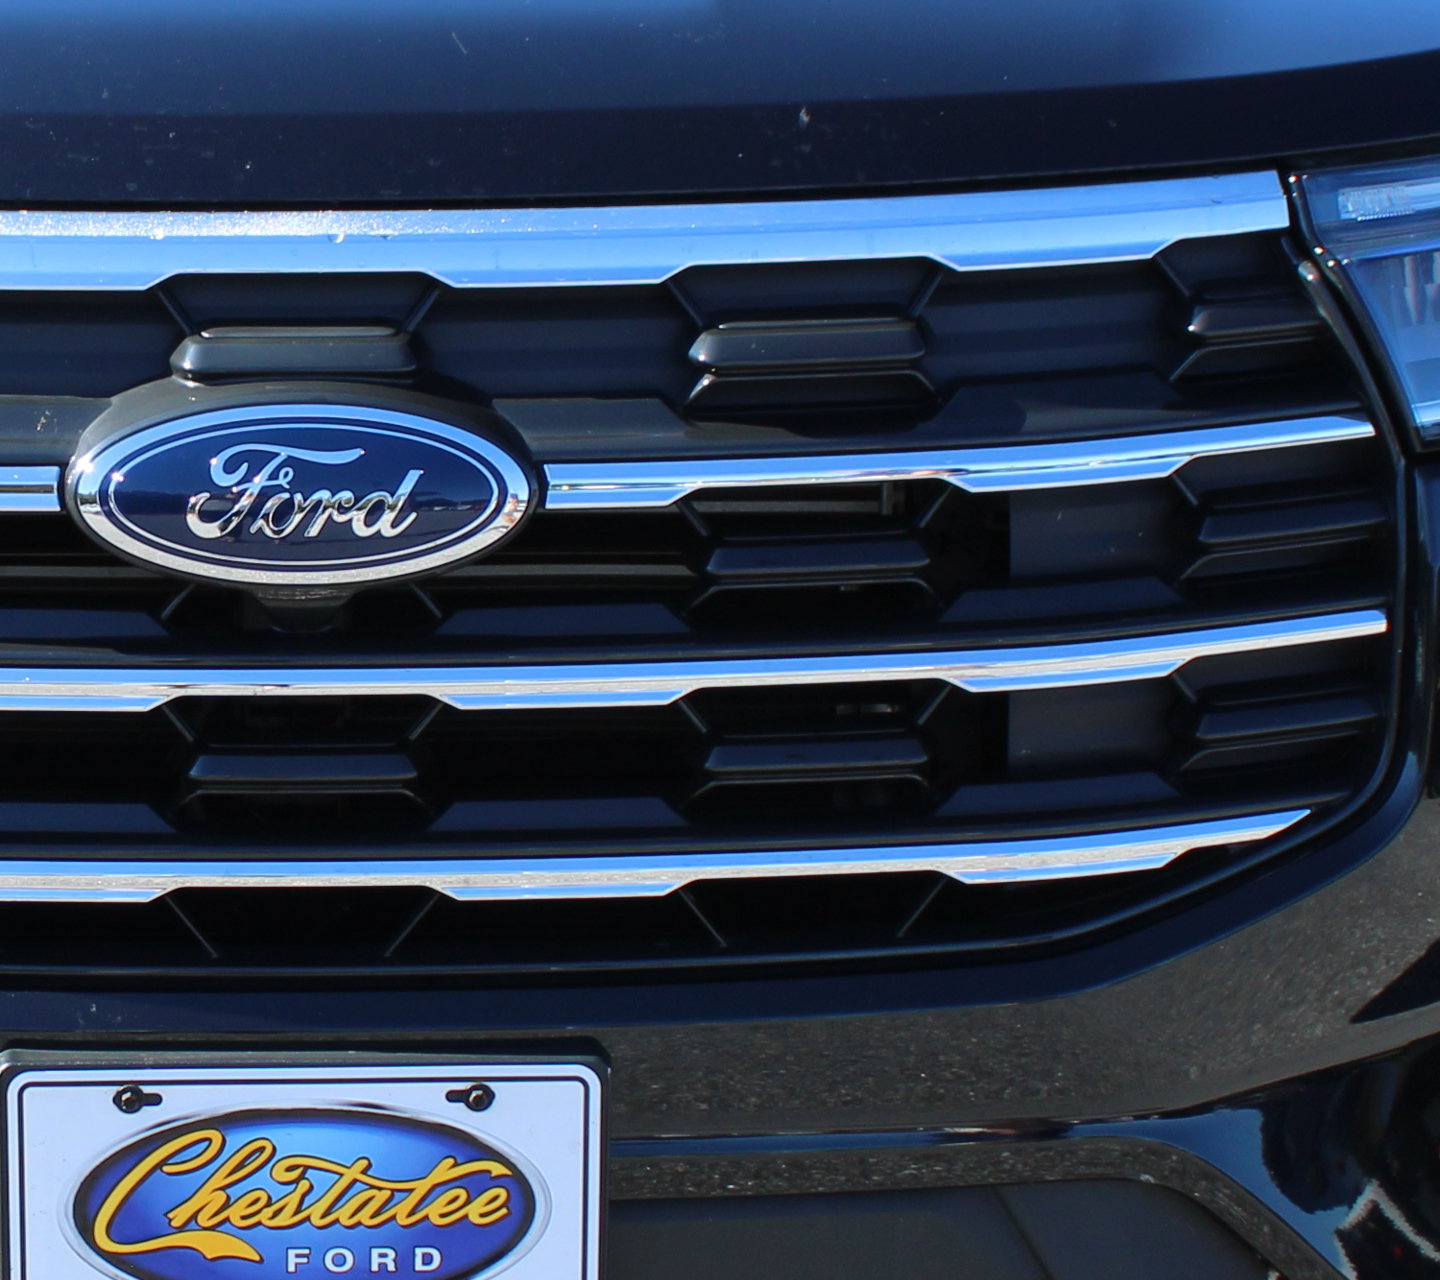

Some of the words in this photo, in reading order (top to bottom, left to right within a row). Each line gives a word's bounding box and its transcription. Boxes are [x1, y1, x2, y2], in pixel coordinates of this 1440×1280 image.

[186, 443, 425, 539] Ford
[93, 1129, 514, 1263] Chestatee
[285, 1246, 444, 1274] FORD
